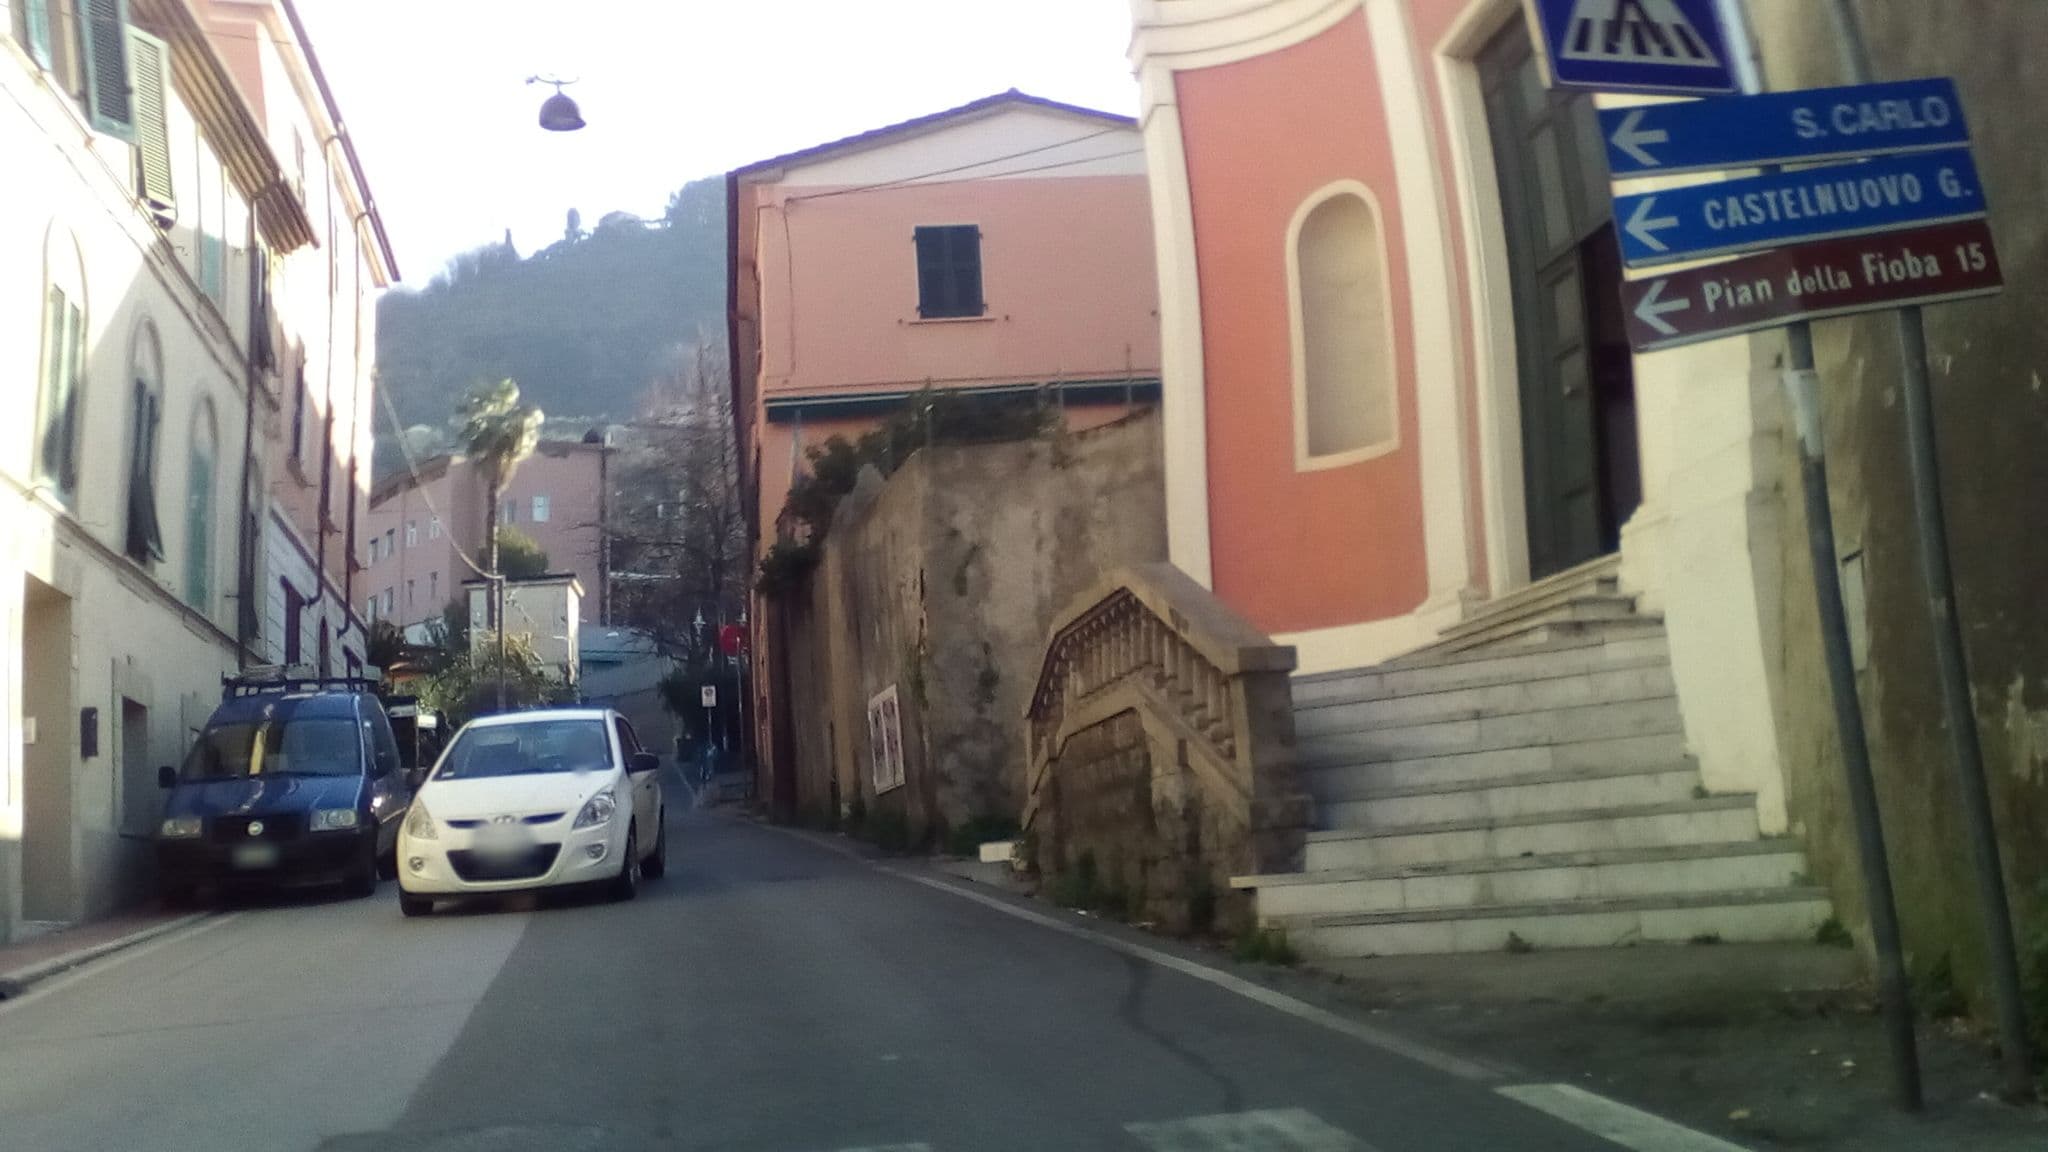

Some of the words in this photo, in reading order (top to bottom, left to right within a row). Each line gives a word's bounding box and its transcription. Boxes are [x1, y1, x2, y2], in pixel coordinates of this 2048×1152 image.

[1791, 107, 1828, 138] S.
[1831, 96, 1951, 135] CARLO
[1704, 173, 1922, 230] CASTELNUOVO
[1938, 167, 1973, 198] G.
[1703, 278, 1773, 313] Pian
[1787, 266, 1852, 297] della
[1861, 249, 1942, 285] Fioba
[1955, 242, 1987, 272] 15
